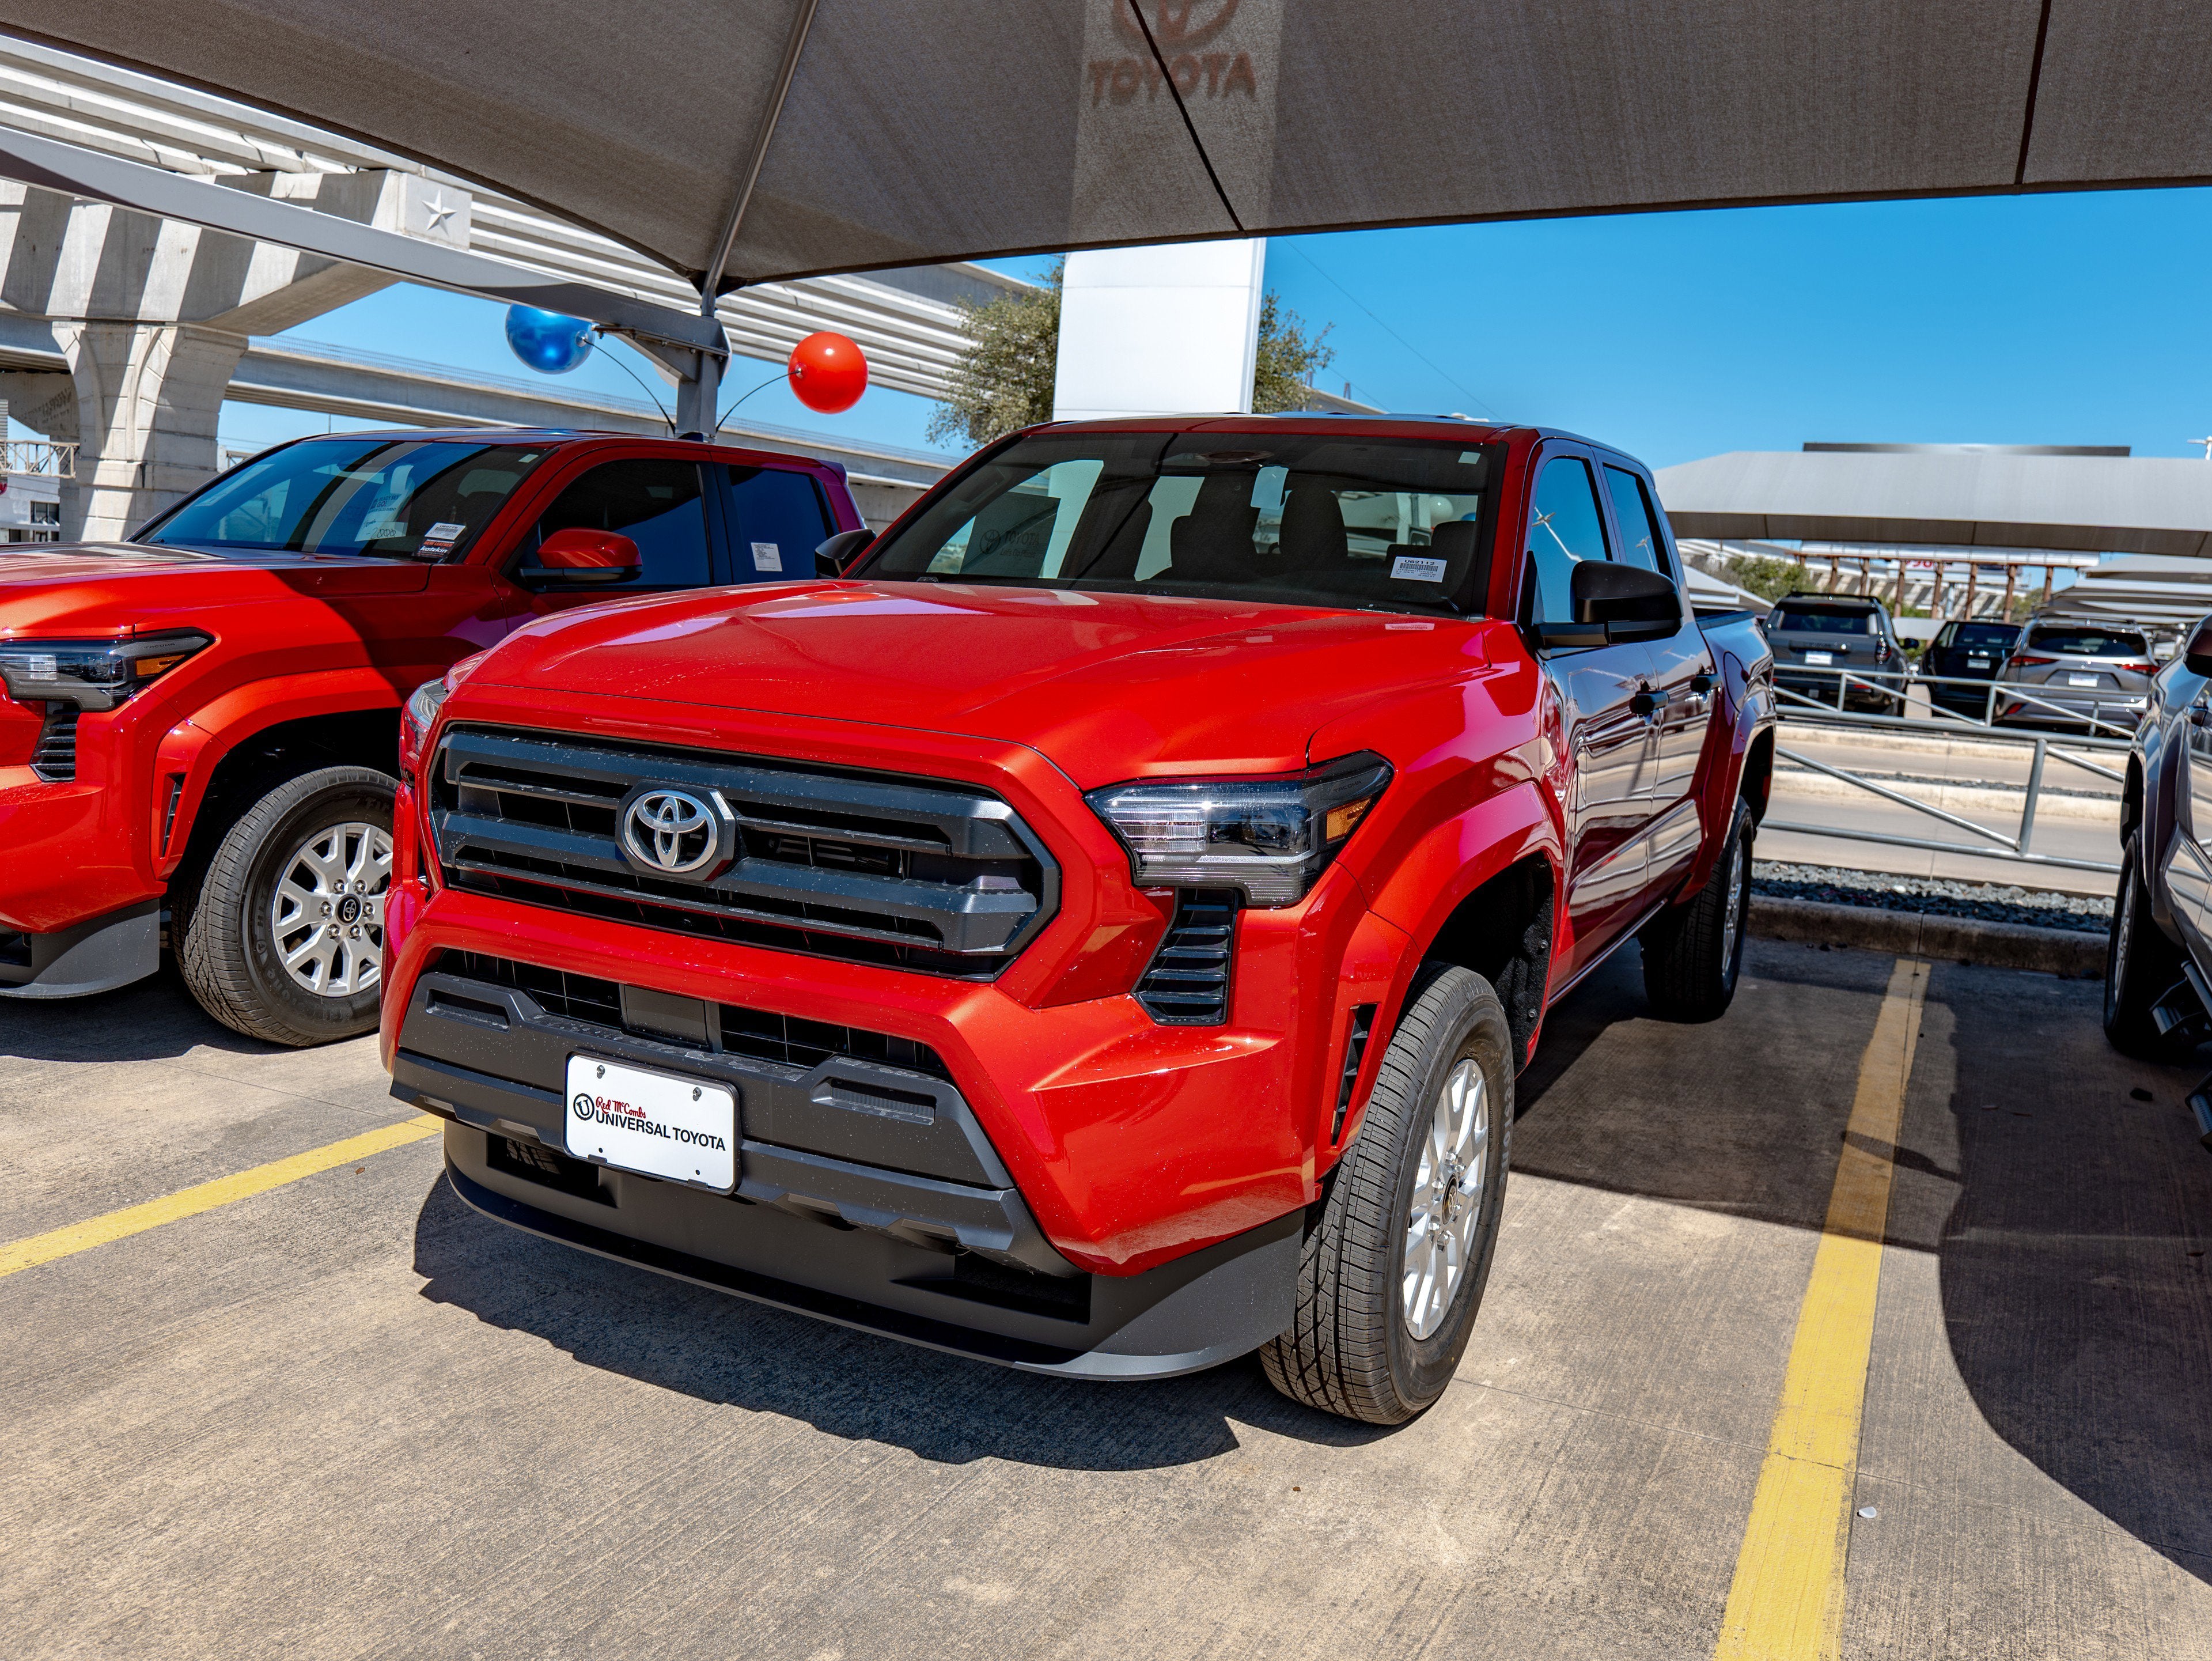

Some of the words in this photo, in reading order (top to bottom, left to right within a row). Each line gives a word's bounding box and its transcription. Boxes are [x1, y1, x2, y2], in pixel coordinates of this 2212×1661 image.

[1088, 52, 1257, 107] TOYOTA
[1334, 780, 1362, 793] TACOMA
[596, 1096, 611, 1114] Red
[596, 1110, 671, 1139] UNIVERSAL
[672, 1127, 726, 1151] TOYOTA
